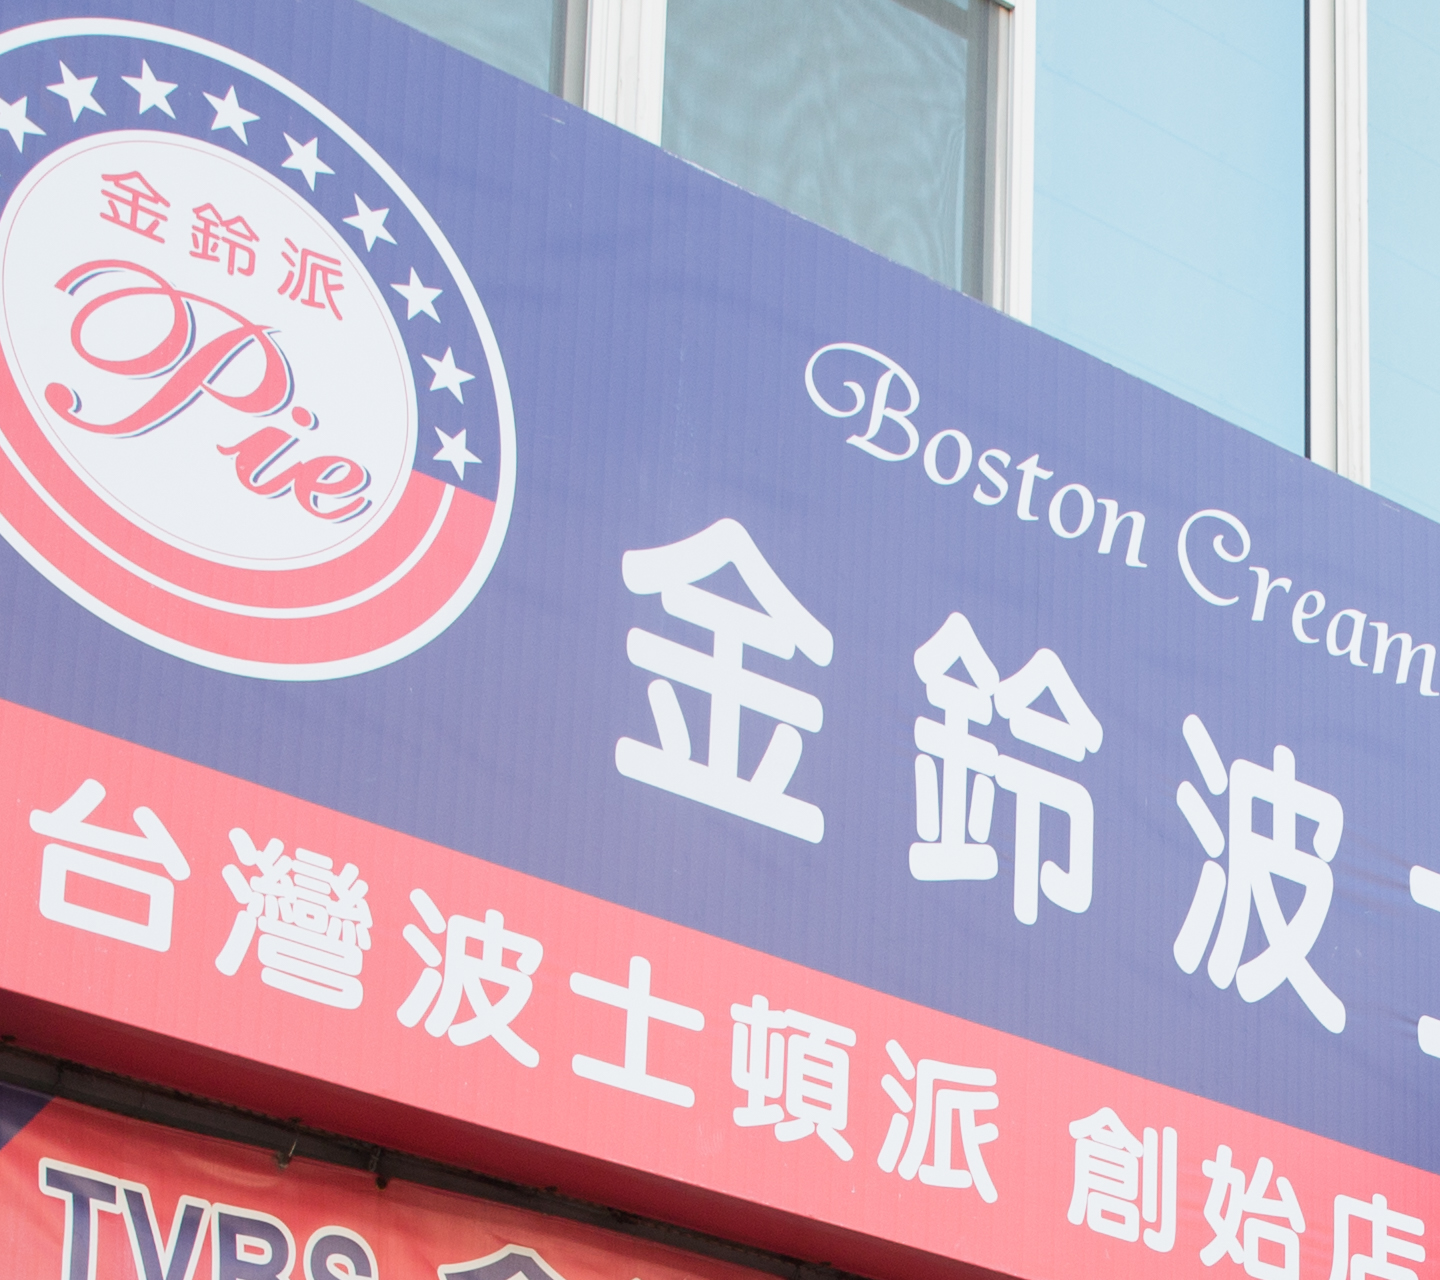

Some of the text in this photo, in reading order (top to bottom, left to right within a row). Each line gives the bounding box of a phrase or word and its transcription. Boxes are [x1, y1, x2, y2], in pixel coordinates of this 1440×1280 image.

[44, 258, 373, 524] Pie
[100, 170, 345, 321] 金鈴派
[804, 343, 1148, 570] Boston
[1177, 508, 1440, 699] Cream
[29, 778, 1000, 1201] 台灣波士頓派
